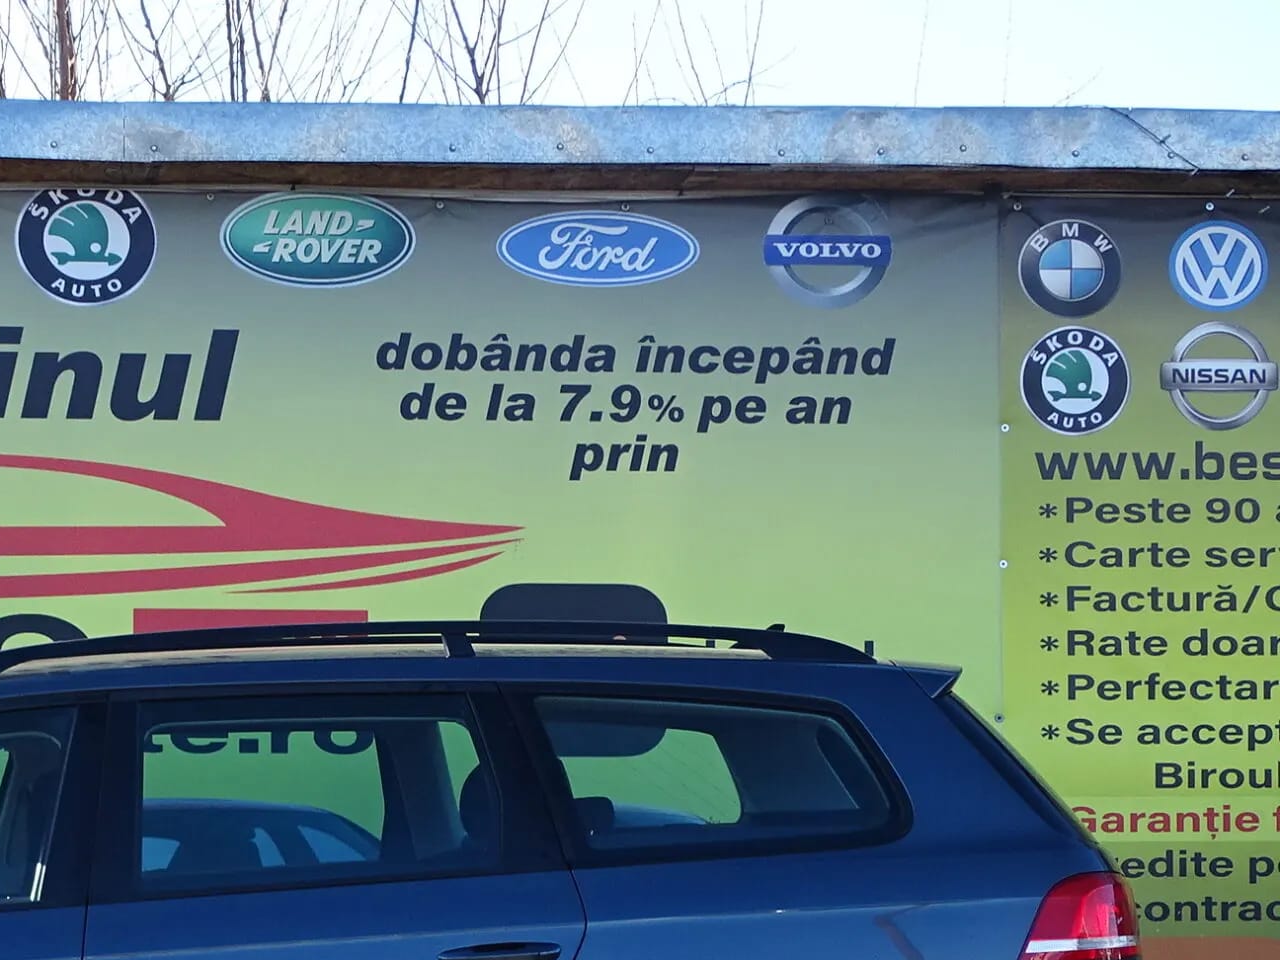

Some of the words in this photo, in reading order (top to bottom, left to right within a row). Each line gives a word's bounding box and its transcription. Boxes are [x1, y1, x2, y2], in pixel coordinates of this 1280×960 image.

[537, 222, 655, 272] Ford
[773, 242, 882, 259] VOLVO
[51, 277, 122, 297] AUTO
[376, 333, 615, 372] dobânda
[636, 336, 896, 382] începând
[1171, 368, 1266, 384] NISSAN
[400, 383, 466, 420] de
[486, 384, 535, 421] la
[697, 395, 766, 432] pe
[786, 397, 851, 424] an
[1047, 411, 1103, 429] AUTO
[569, 435, 678, 480] prin
[1035, 441, 1280, 480] www.bes
[1206, 498, 1260, 523] 90
[1205, 548, 1280, 567] ser
[1156, 761, 1280, 789] Birou
[1115, 850, 1234, 878] edite
